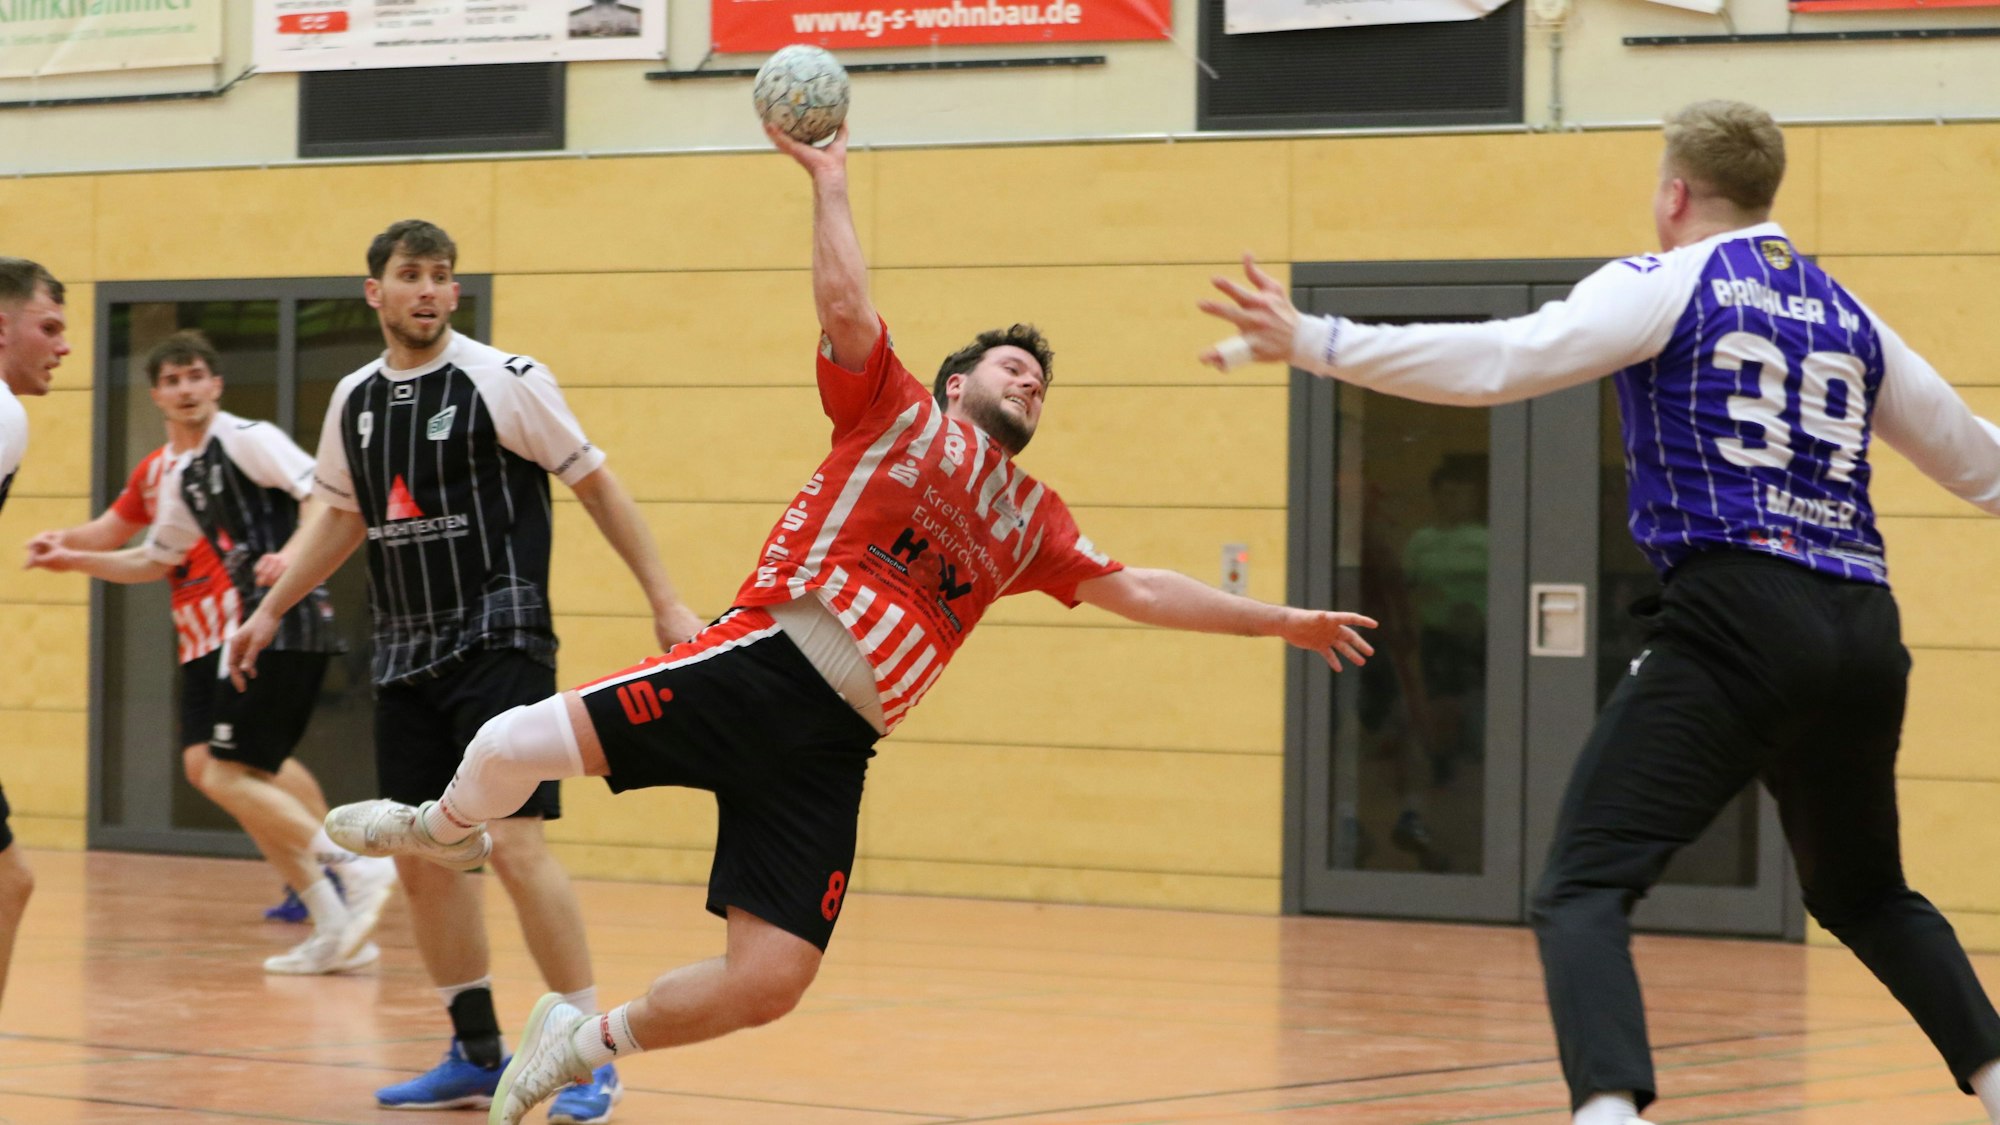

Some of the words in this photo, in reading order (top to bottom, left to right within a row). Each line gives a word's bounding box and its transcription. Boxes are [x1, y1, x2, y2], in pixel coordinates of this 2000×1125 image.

[792, 0, 1081, 38] www.g-s-wohnbau.de
[1712, 331, 1867, 482] 39
[357, 410, 374, 448] 9
[942, 433, 967, 466] 8
[868, 545, 907, 573] Hamacher
[912, 505, 979, 583] Euskirchn
[821, 870, 845, 921] 8
